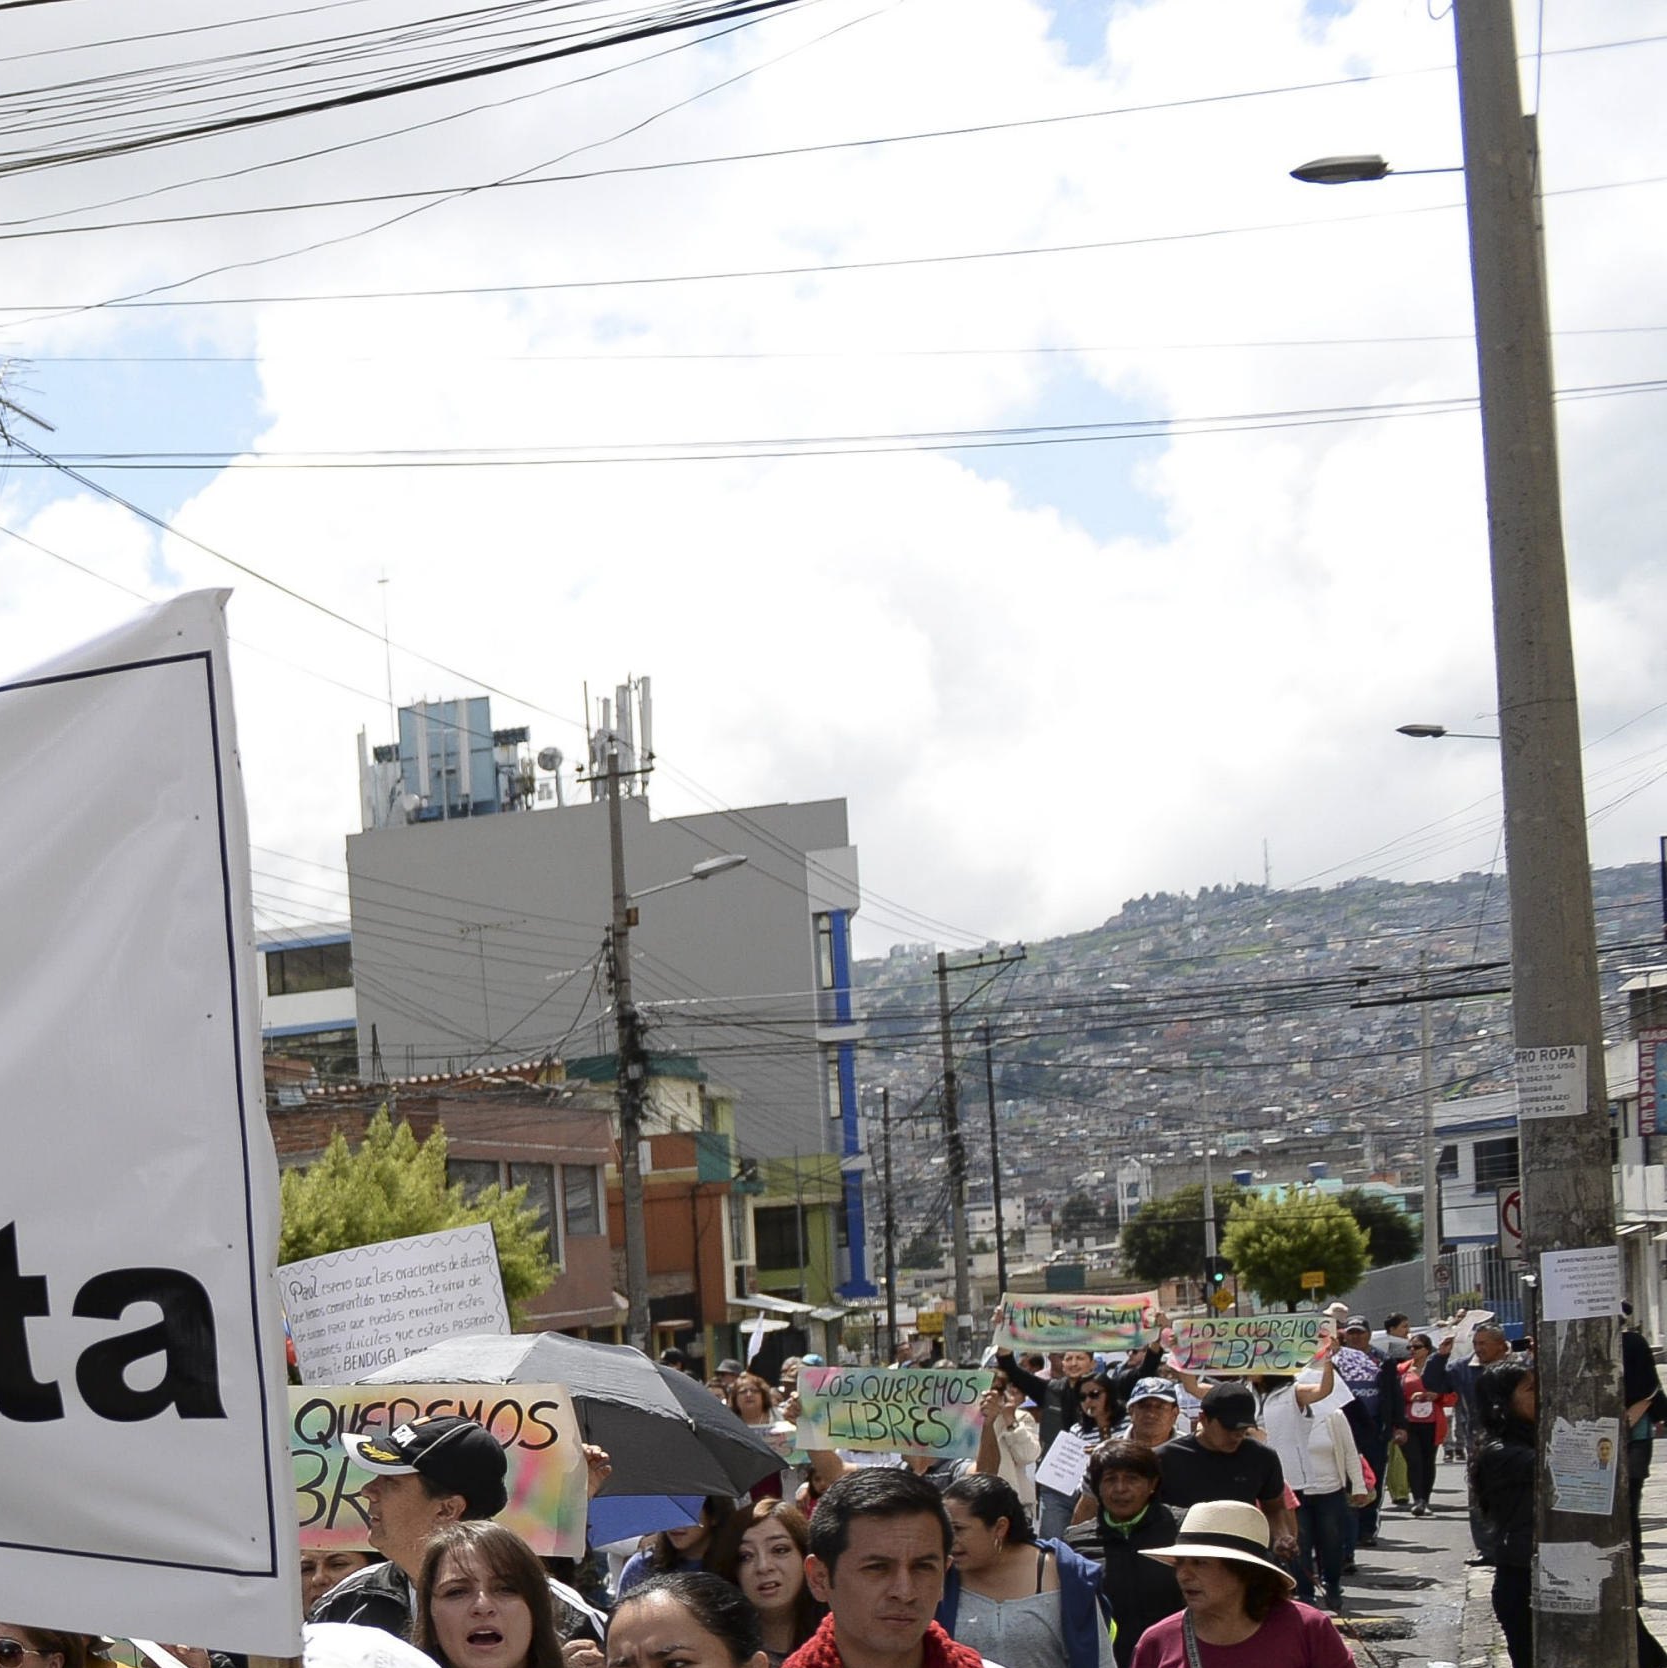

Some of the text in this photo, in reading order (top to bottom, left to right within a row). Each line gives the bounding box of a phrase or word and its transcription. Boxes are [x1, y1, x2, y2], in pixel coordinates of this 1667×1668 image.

[1540, 1047, 1576, 1062] ROPA
[1640, 1041, 1656, 1134] ESCAPES
[1189, 1321, 1227, 1339] LOS
[1182, 1338, 1319, 1369] LIBRES
[815, 1374, 979, 1407] LOS QUEREMOS
[826, 1400, 952, 1449] LIBRES
